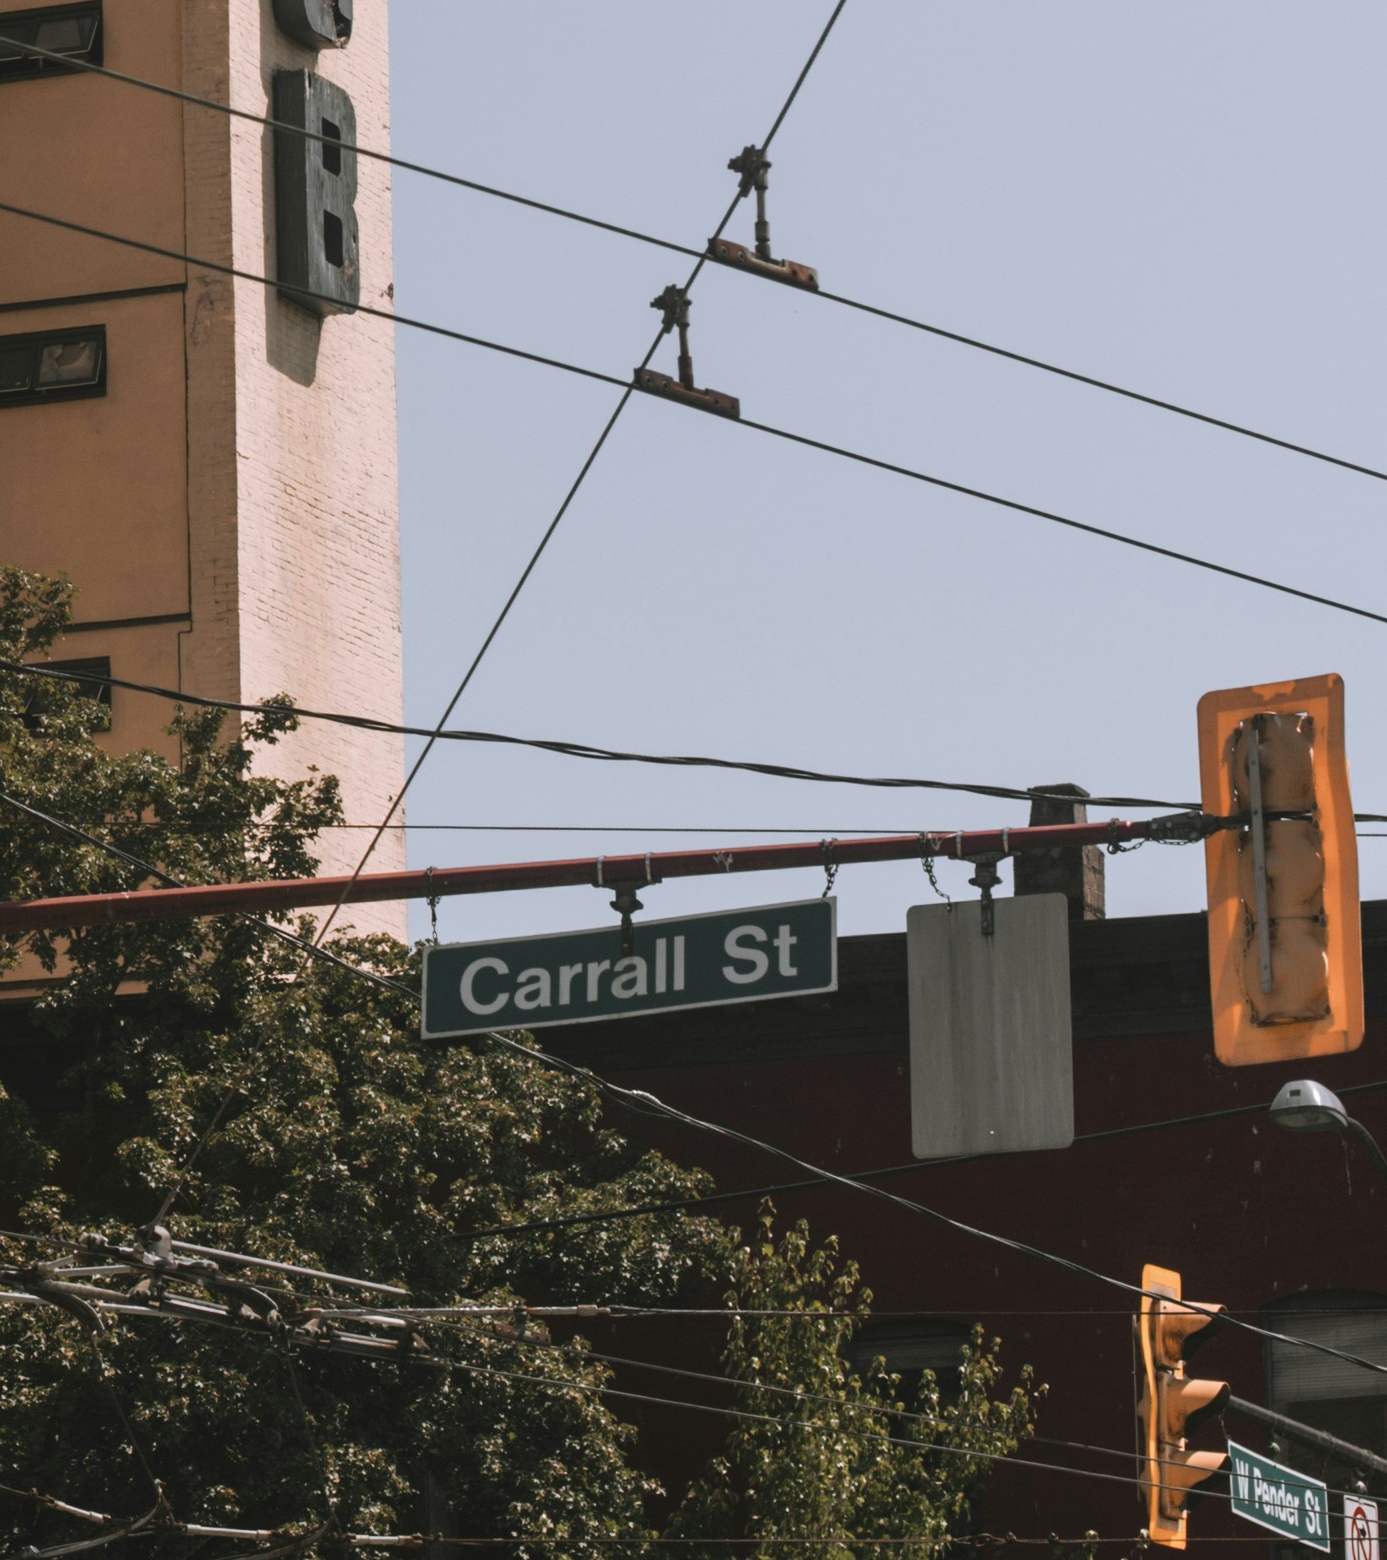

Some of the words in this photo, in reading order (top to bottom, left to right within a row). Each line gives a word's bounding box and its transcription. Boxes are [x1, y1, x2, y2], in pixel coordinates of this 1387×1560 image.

[459, 935, 686, 1016] Carrall
[722, 924, 799, 984] St
[1236, 1458, 1249, 1505] W
[1253, 1466, 1300, 1527] Pender
[1304, 1489, 1322, 1536] St
